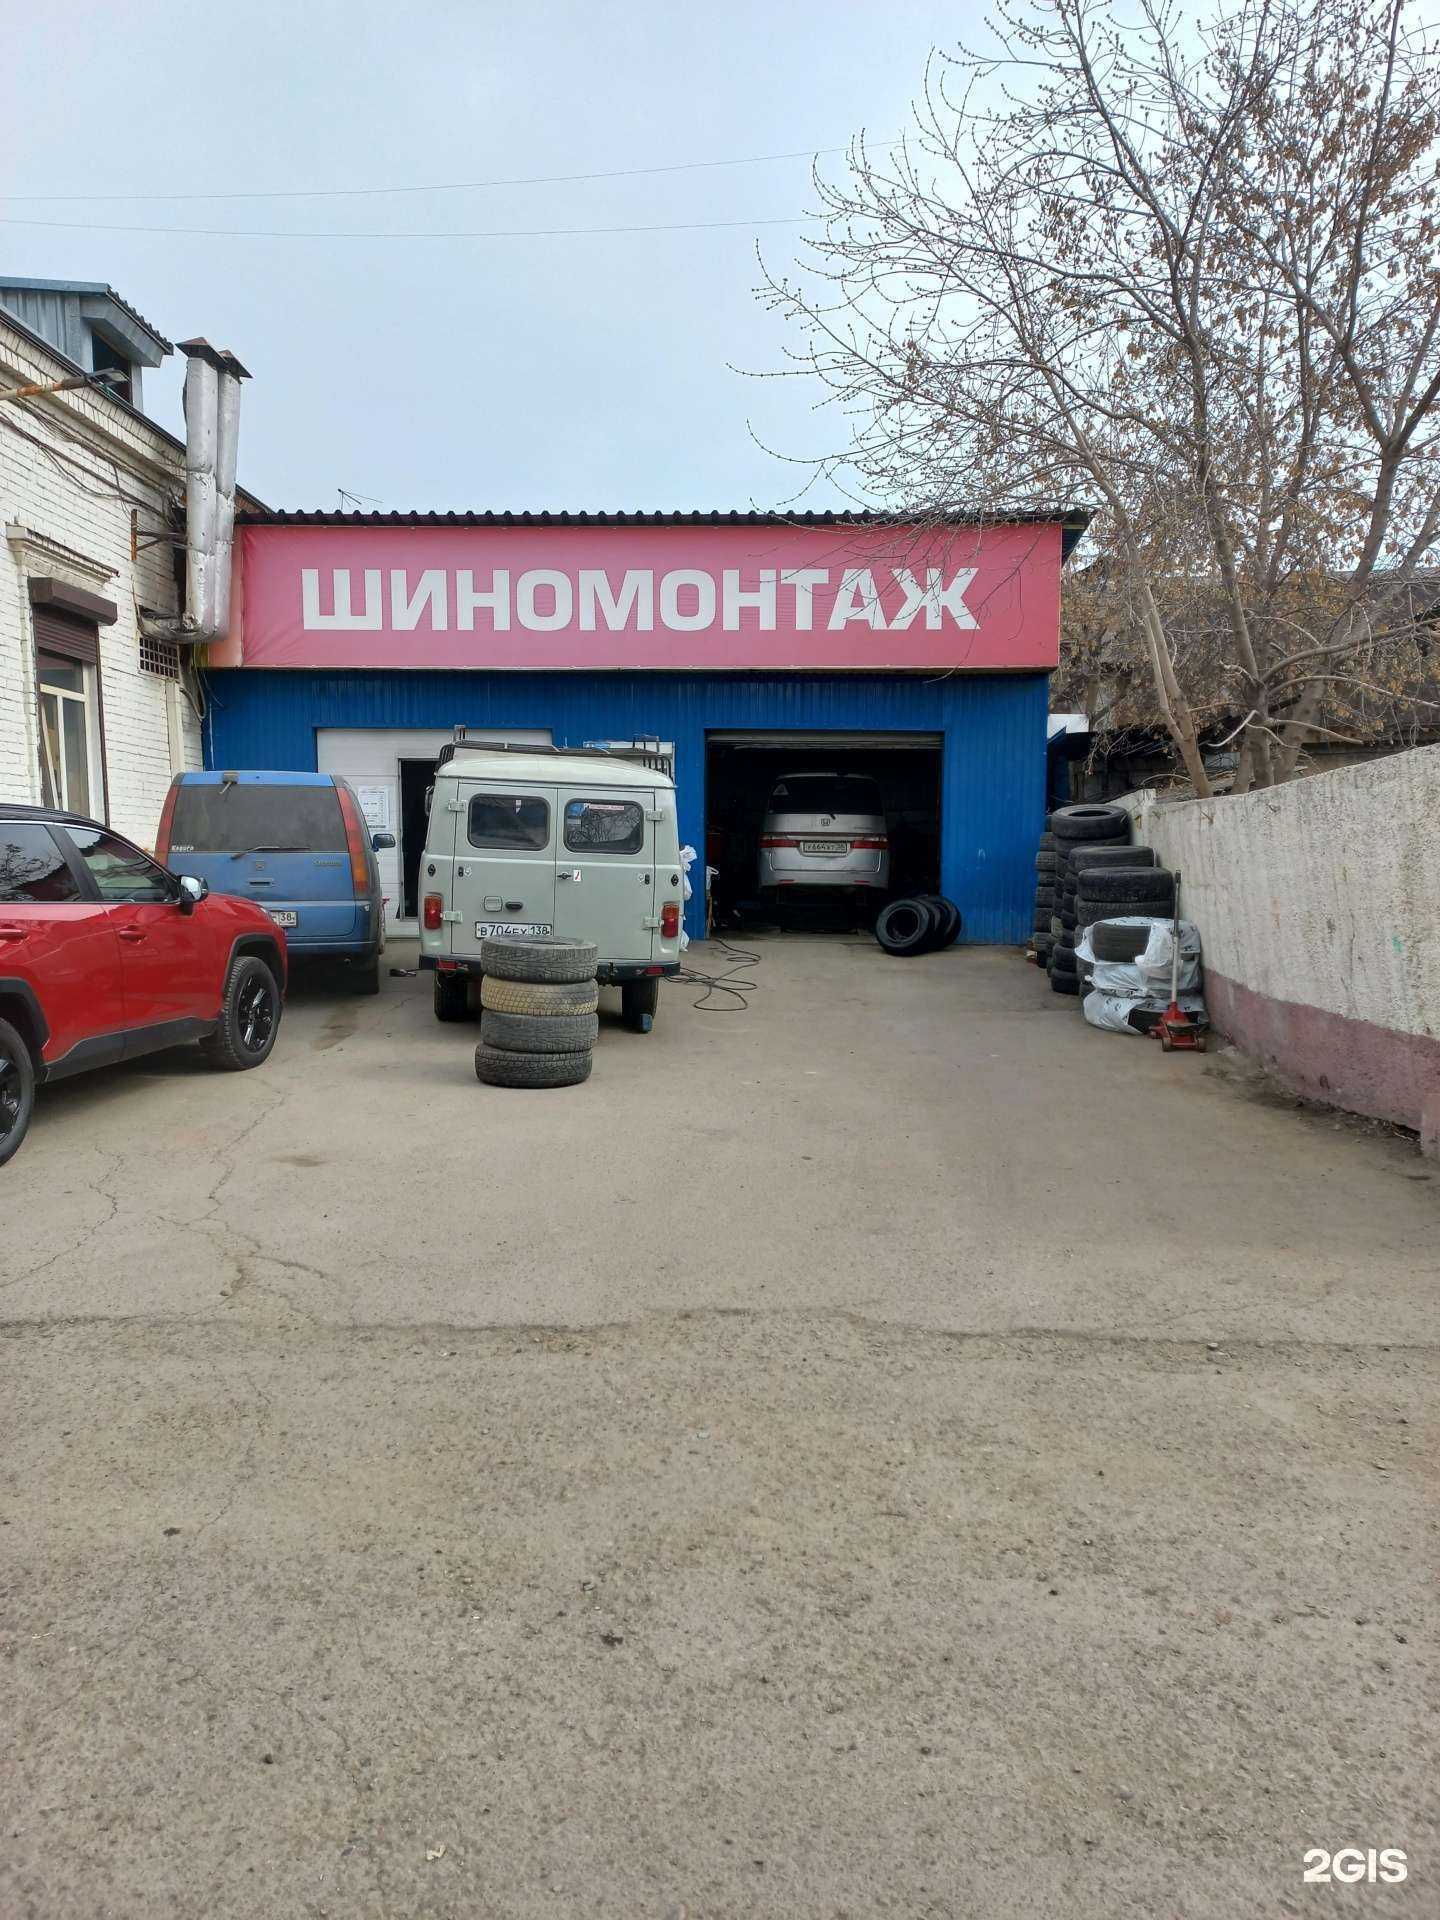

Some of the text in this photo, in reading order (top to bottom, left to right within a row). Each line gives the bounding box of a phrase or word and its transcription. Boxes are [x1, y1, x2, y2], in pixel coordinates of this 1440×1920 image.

[301, 567, 981, 631] ШИНОМОНТАЖ
[280, 912, 292, 921] 38
[530, 925, 548, 935] 138
